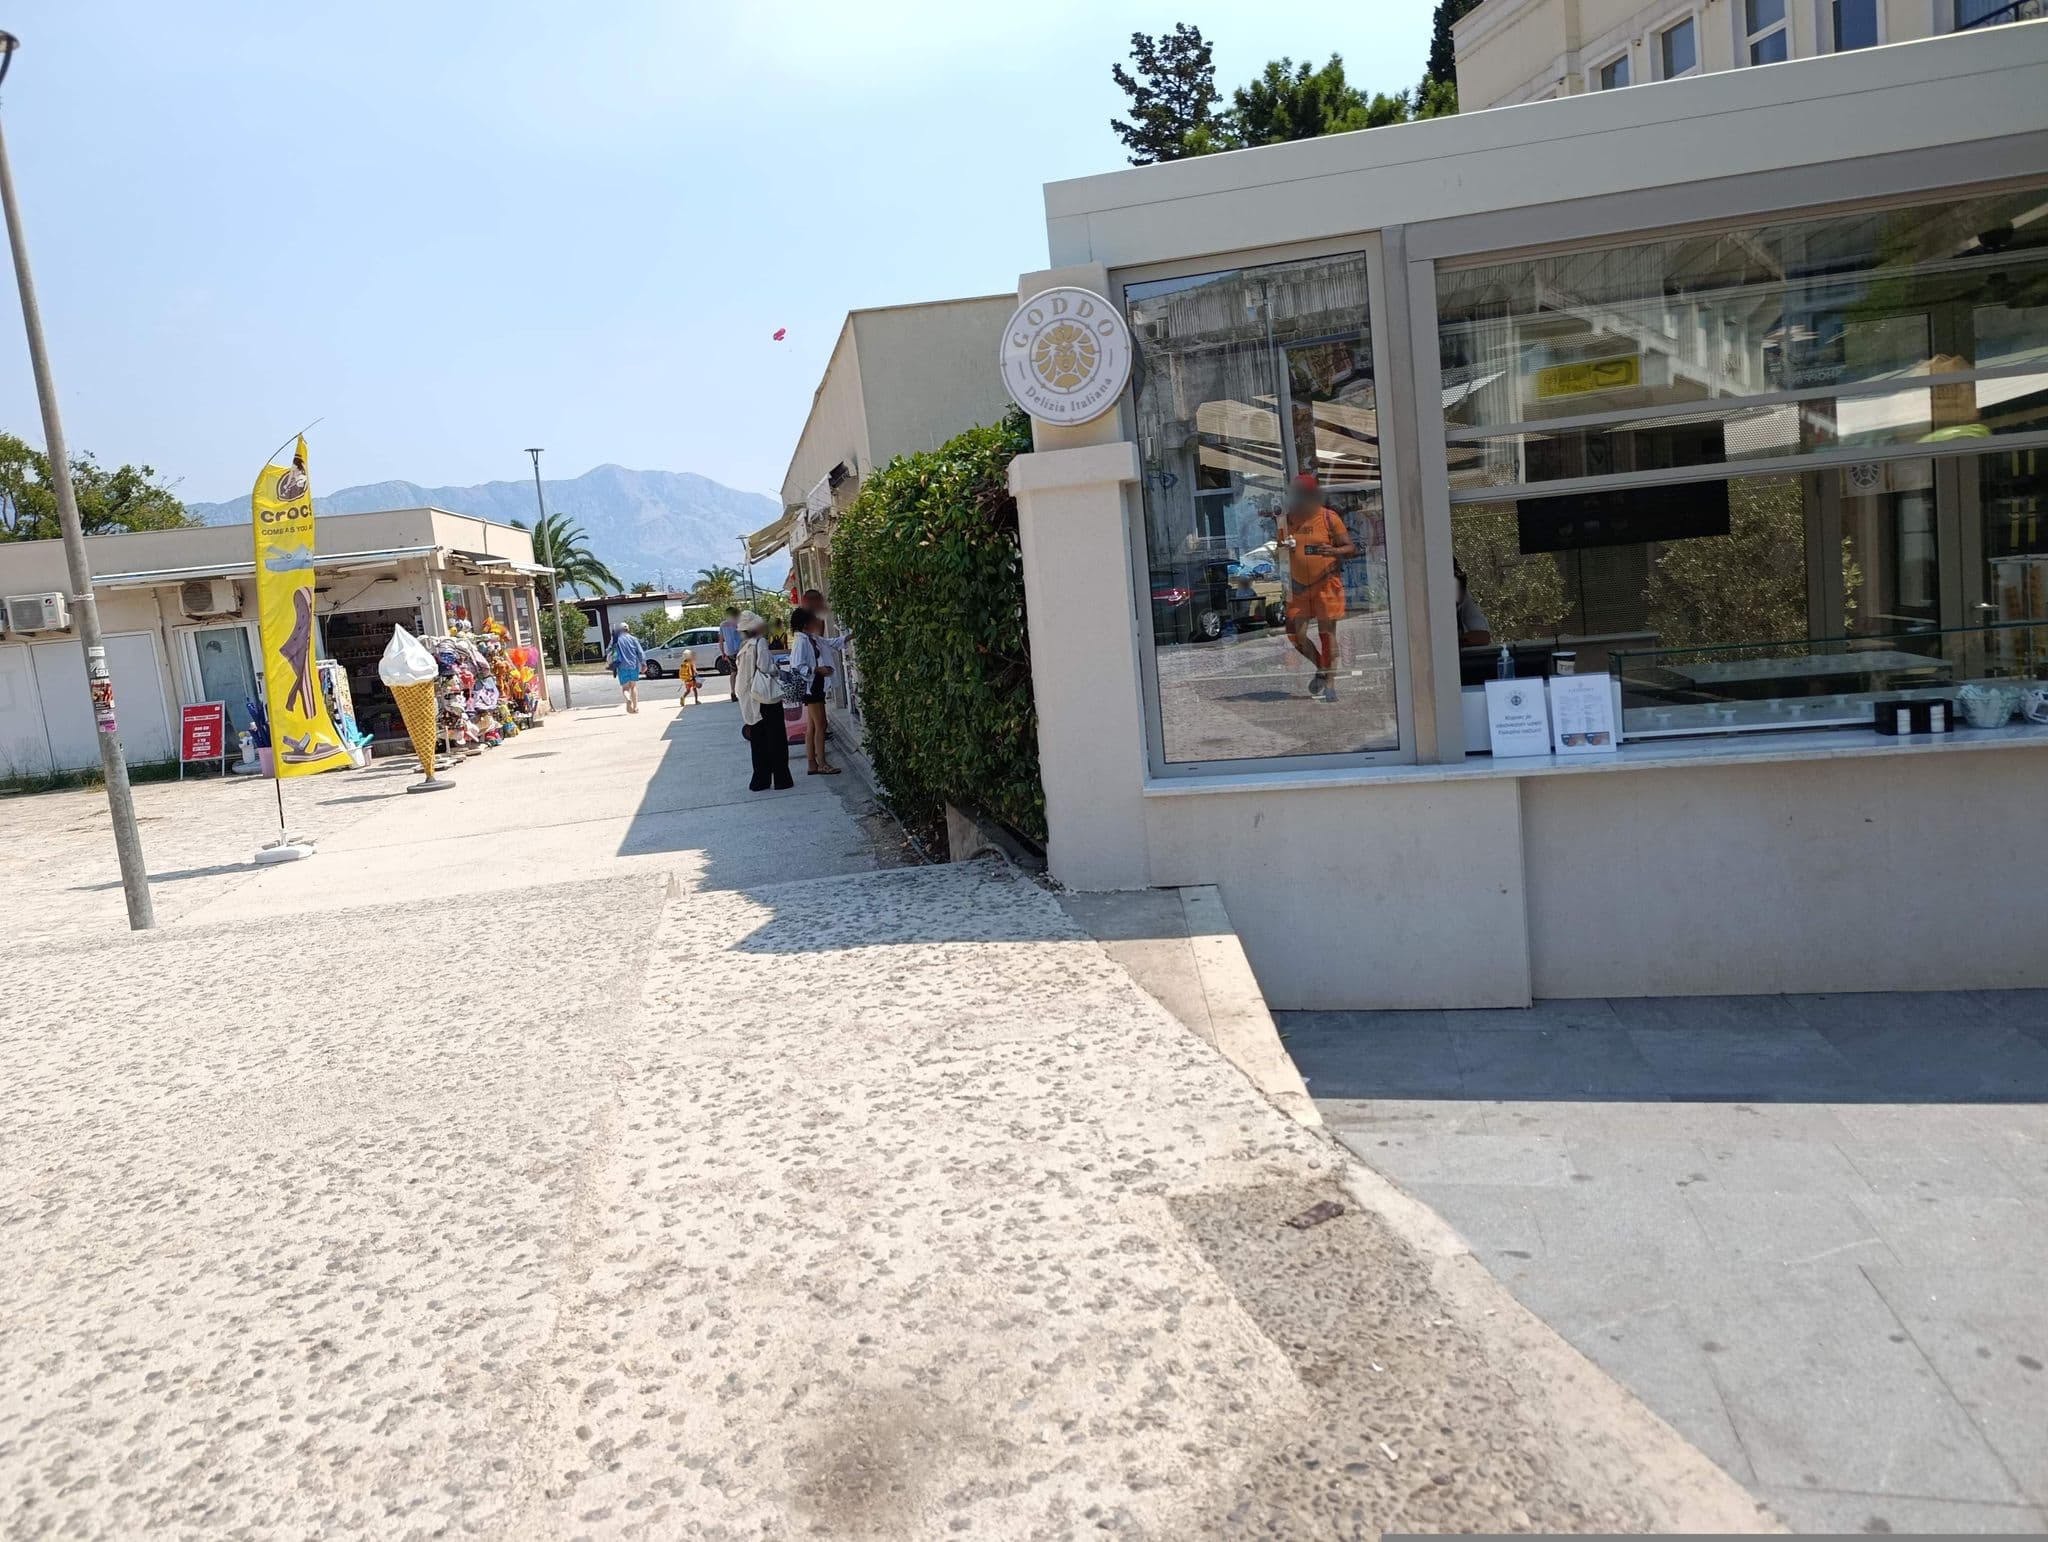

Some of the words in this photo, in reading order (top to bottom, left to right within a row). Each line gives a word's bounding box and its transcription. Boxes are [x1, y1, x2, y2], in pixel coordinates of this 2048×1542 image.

[1012, 297, 1115, 348] GODDO
[1025, 385, 1066, 412] Delizia
[1071, 377, 1112, 412] Italiana
[261, 528, 284, 536] COME
